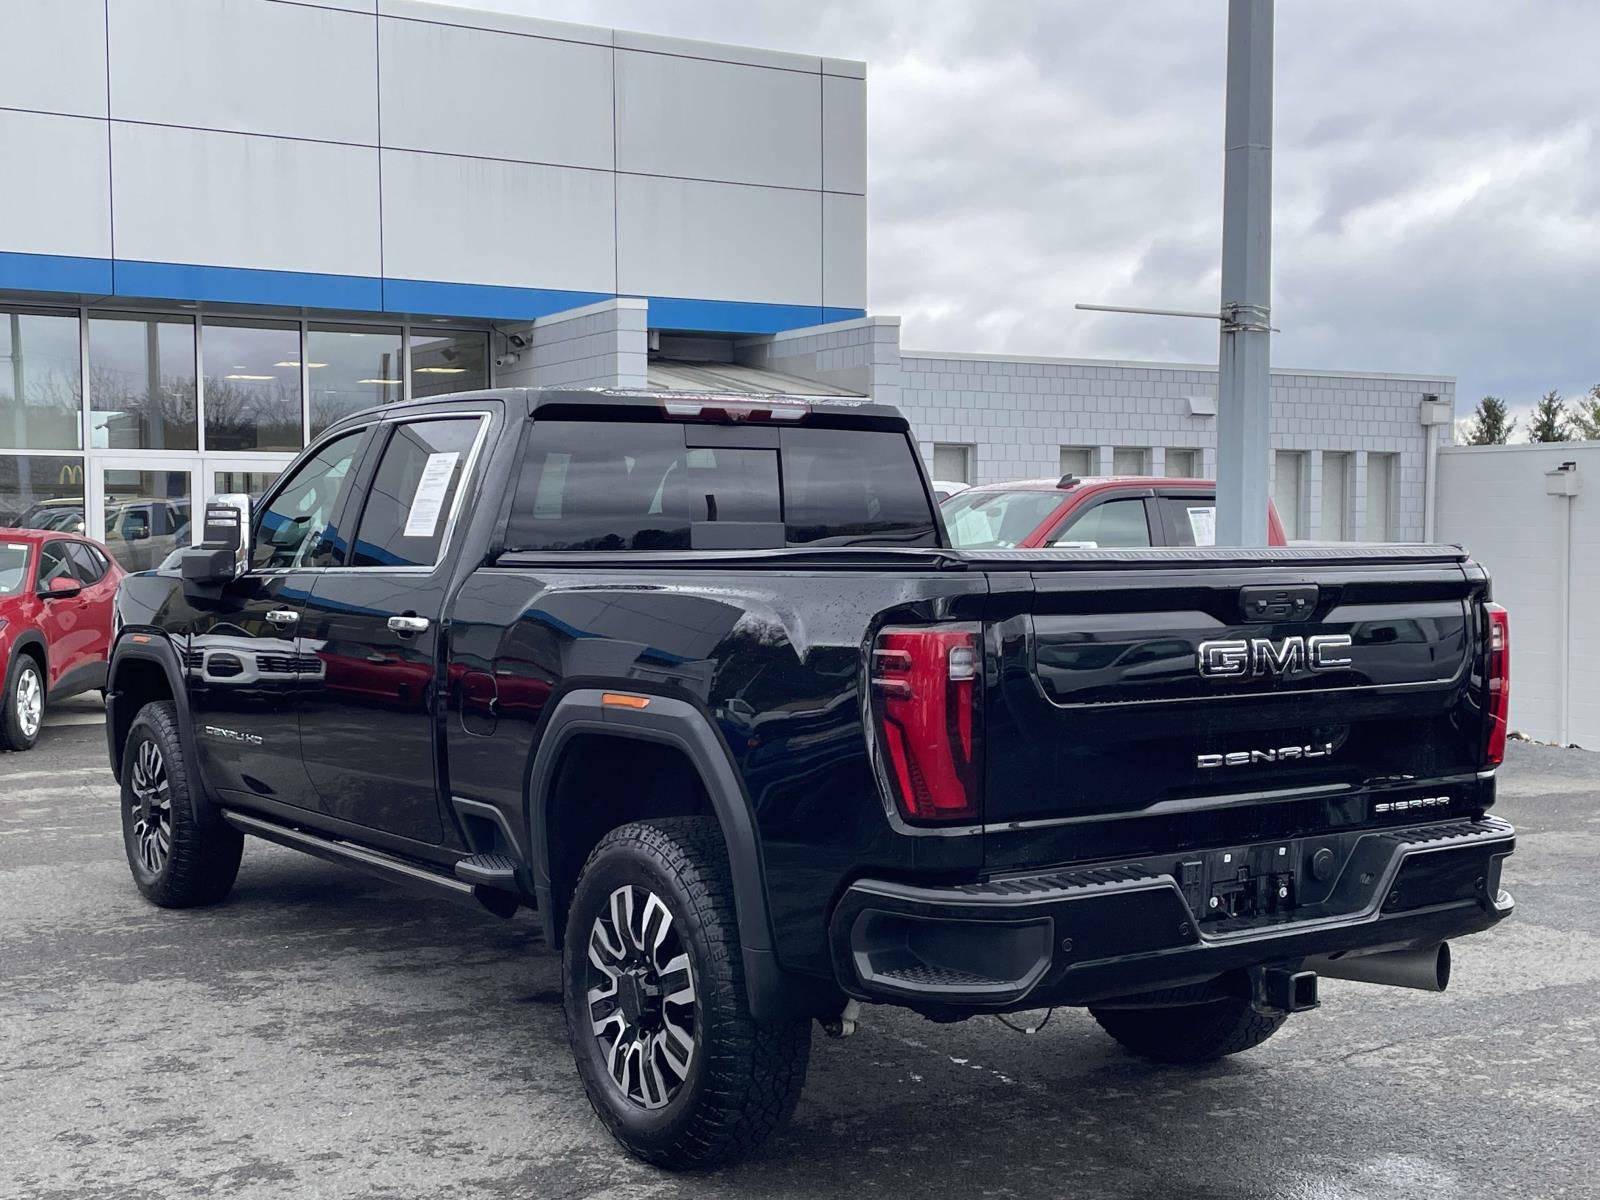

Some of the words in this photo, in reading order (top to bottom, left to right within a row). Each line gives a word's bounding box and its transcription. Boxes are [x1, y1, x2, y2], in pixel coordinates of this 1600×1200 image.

[1198, 634, 1352, 679] GMC
[1197, 742, 1333, 769] DENALI
[1375, 796, 1450, 813] SIERRA
